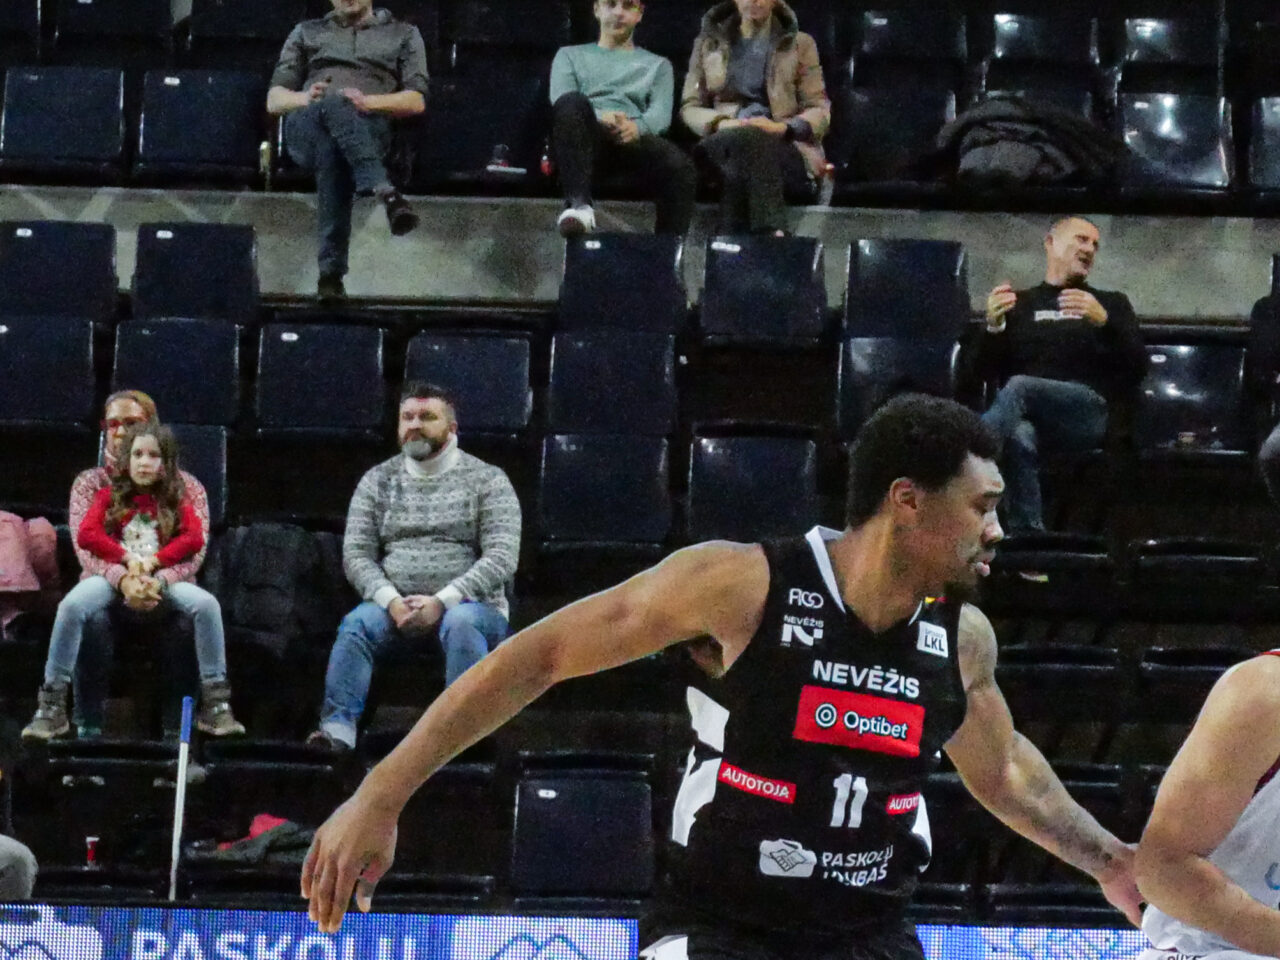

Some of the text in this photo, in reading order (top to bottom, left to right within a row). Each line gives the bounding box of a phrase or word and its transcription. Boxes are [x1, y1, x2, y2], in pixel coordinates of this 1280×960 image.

[924, 638, 946, 652] LKL
[813, 659, 920, 699] NEVĖŽIS
[843, 710, 909, 740] Optibet
[722, 767, 790, 799] AUTOTOJA
[829, 773, 869, 829] 11
